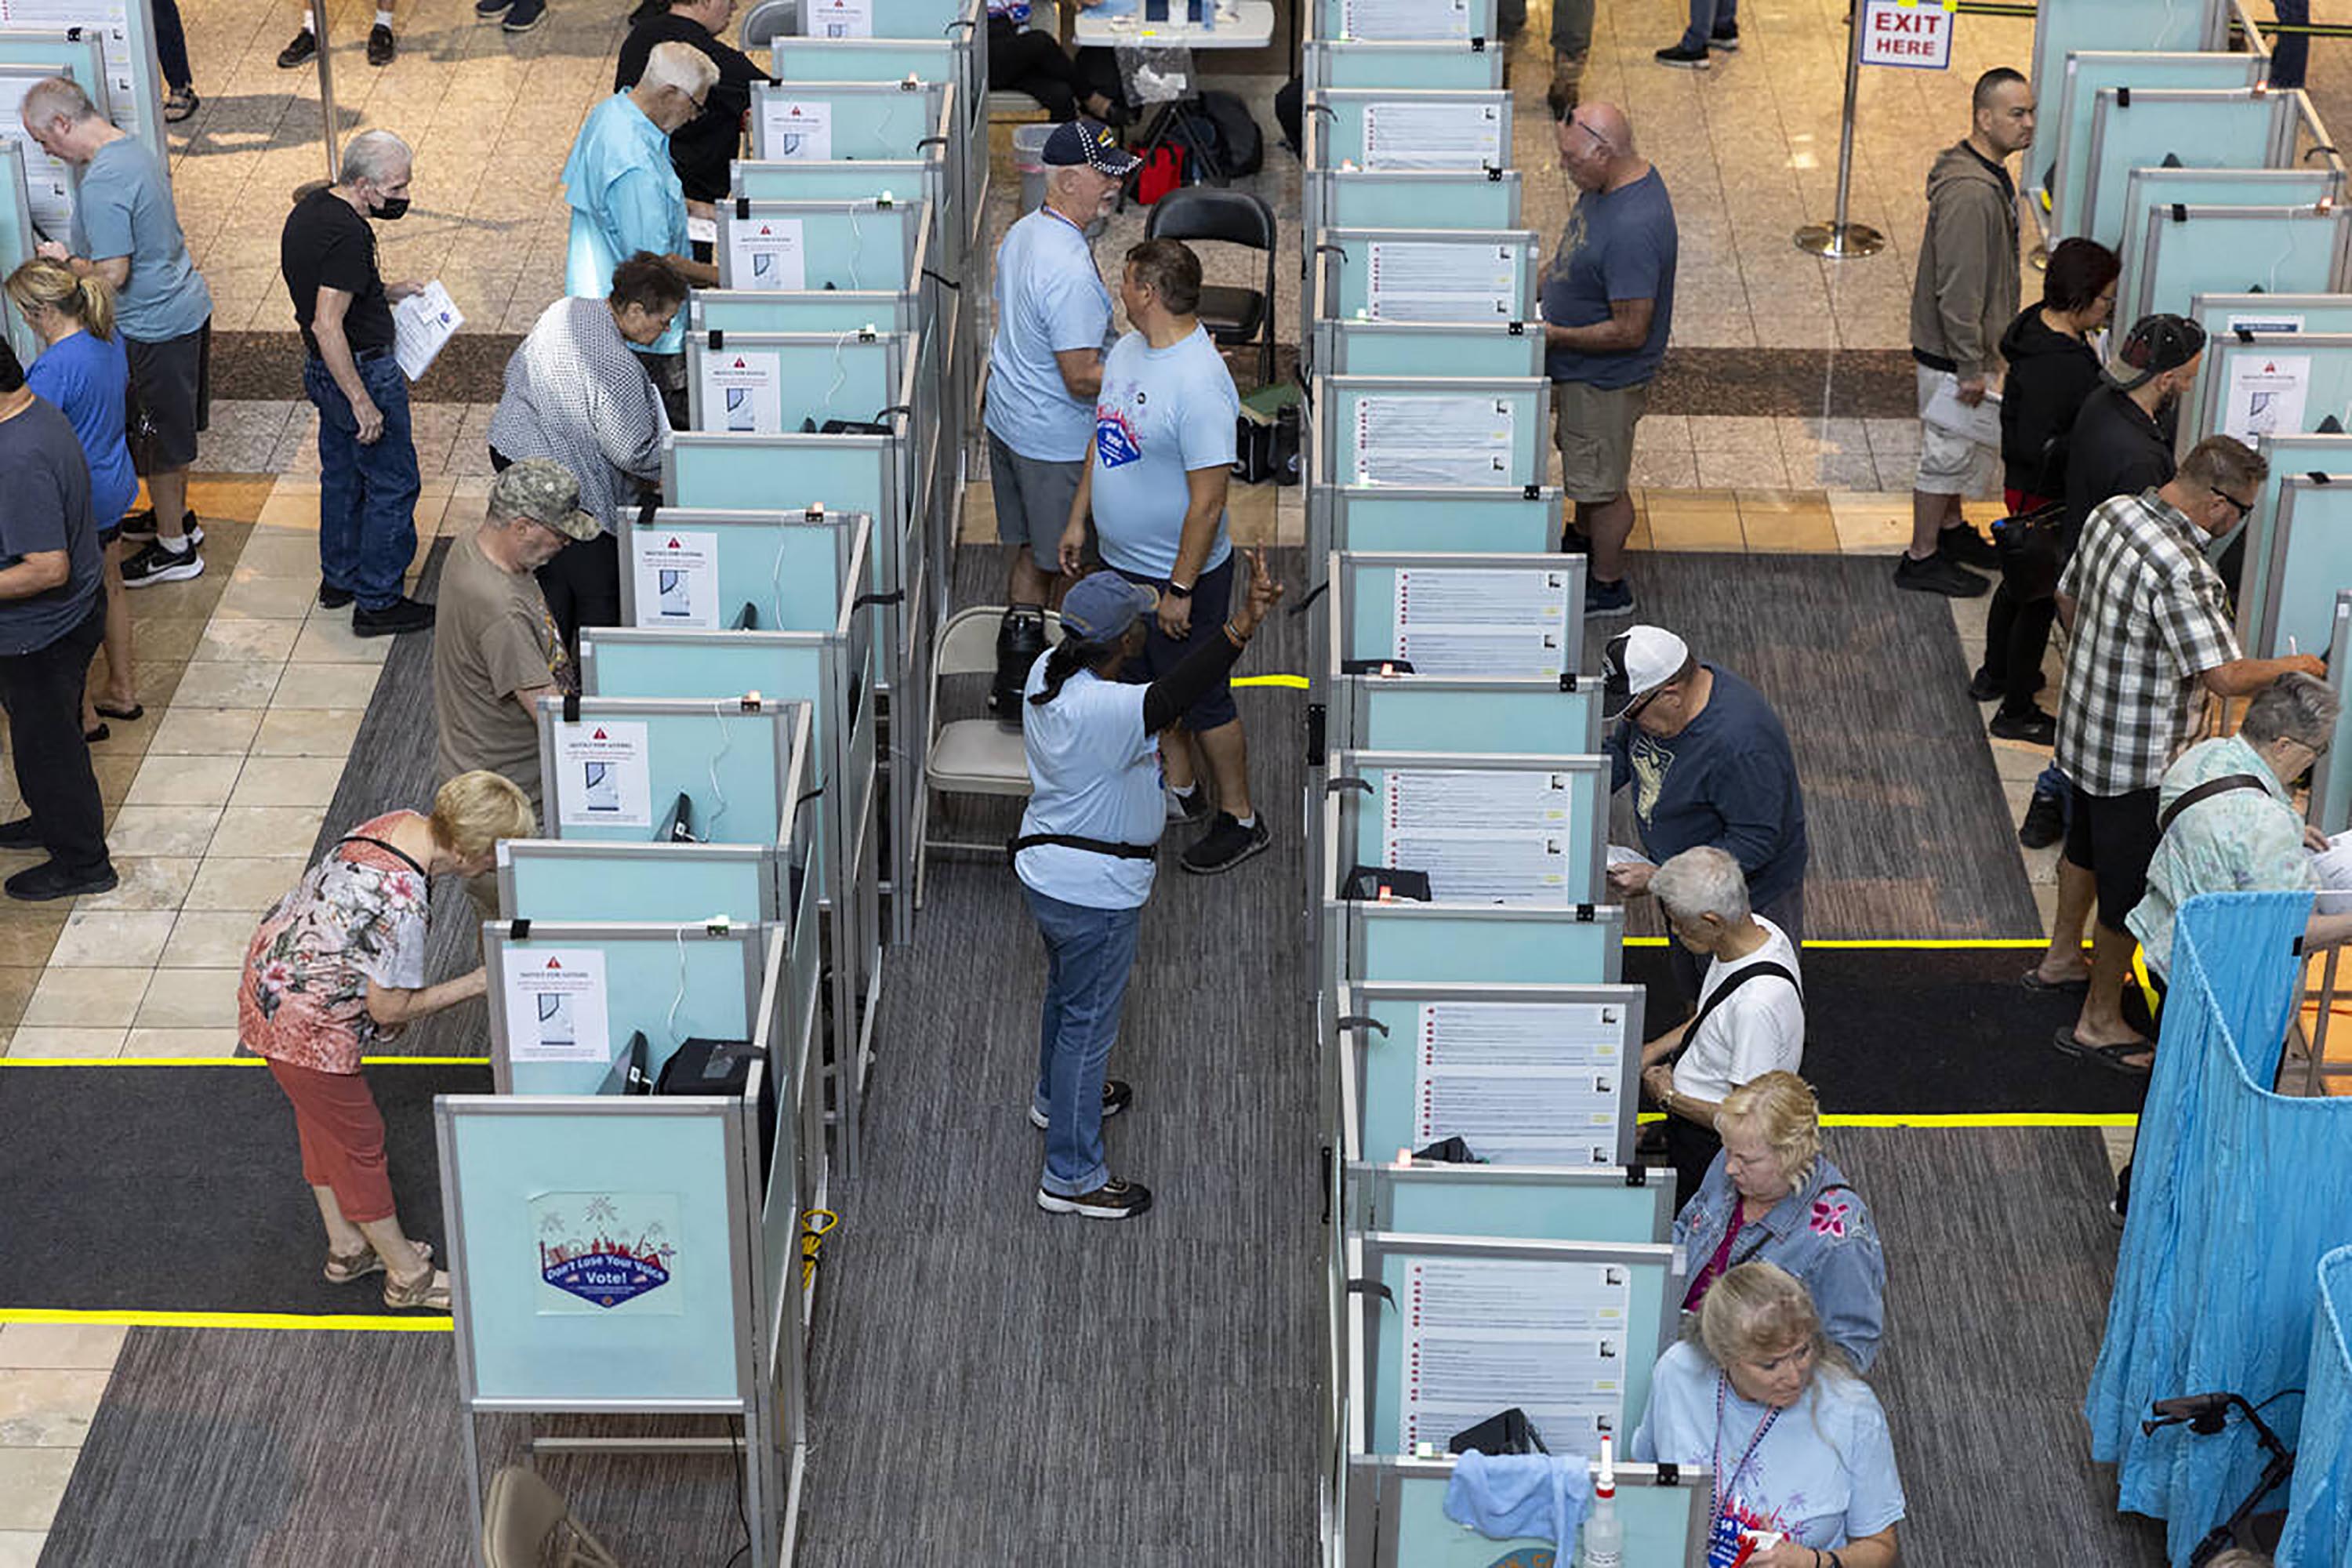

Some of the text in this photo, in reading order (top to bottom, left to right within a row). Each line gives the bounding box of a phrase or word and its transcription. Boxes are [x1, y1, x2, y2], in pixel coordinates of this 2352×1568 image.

[1875, 12, 1941, 34] EXIT
[1876, 38, 1935, 56] HERE
[577, 1256, 604, 1269] Lose
[605, 1255, 632, 1269] Your
[586, 1272, 627, 1284] Vote!
